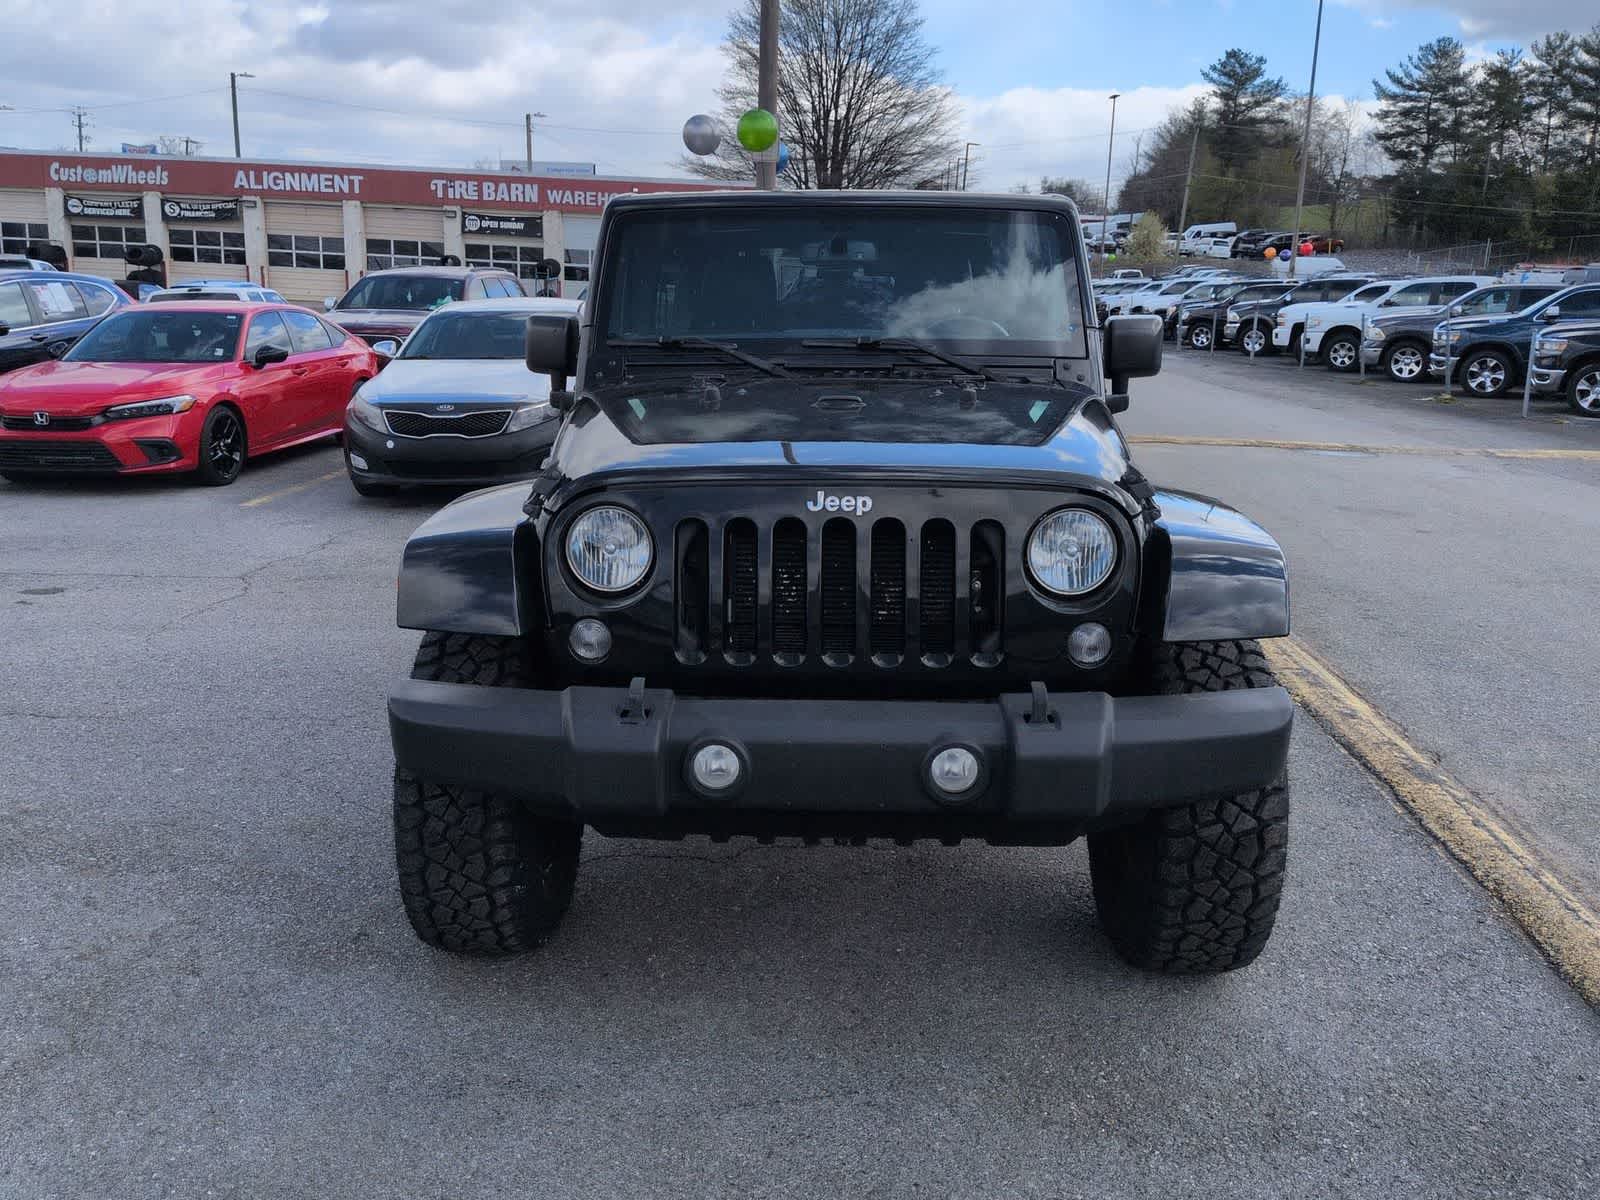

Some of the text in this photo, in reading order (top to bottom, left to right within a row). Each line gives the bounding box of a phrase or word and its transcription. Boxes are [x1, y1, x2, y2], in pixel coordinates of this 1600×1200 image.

[234, 170, 363, 194] ALIGNMENT
[482, 182, 539, 203] BARN
[481, 220, 498, 229] OPEN
[500, 221, 525, 230] SUNDAY
[807, 490, 872, 516] Jeep
